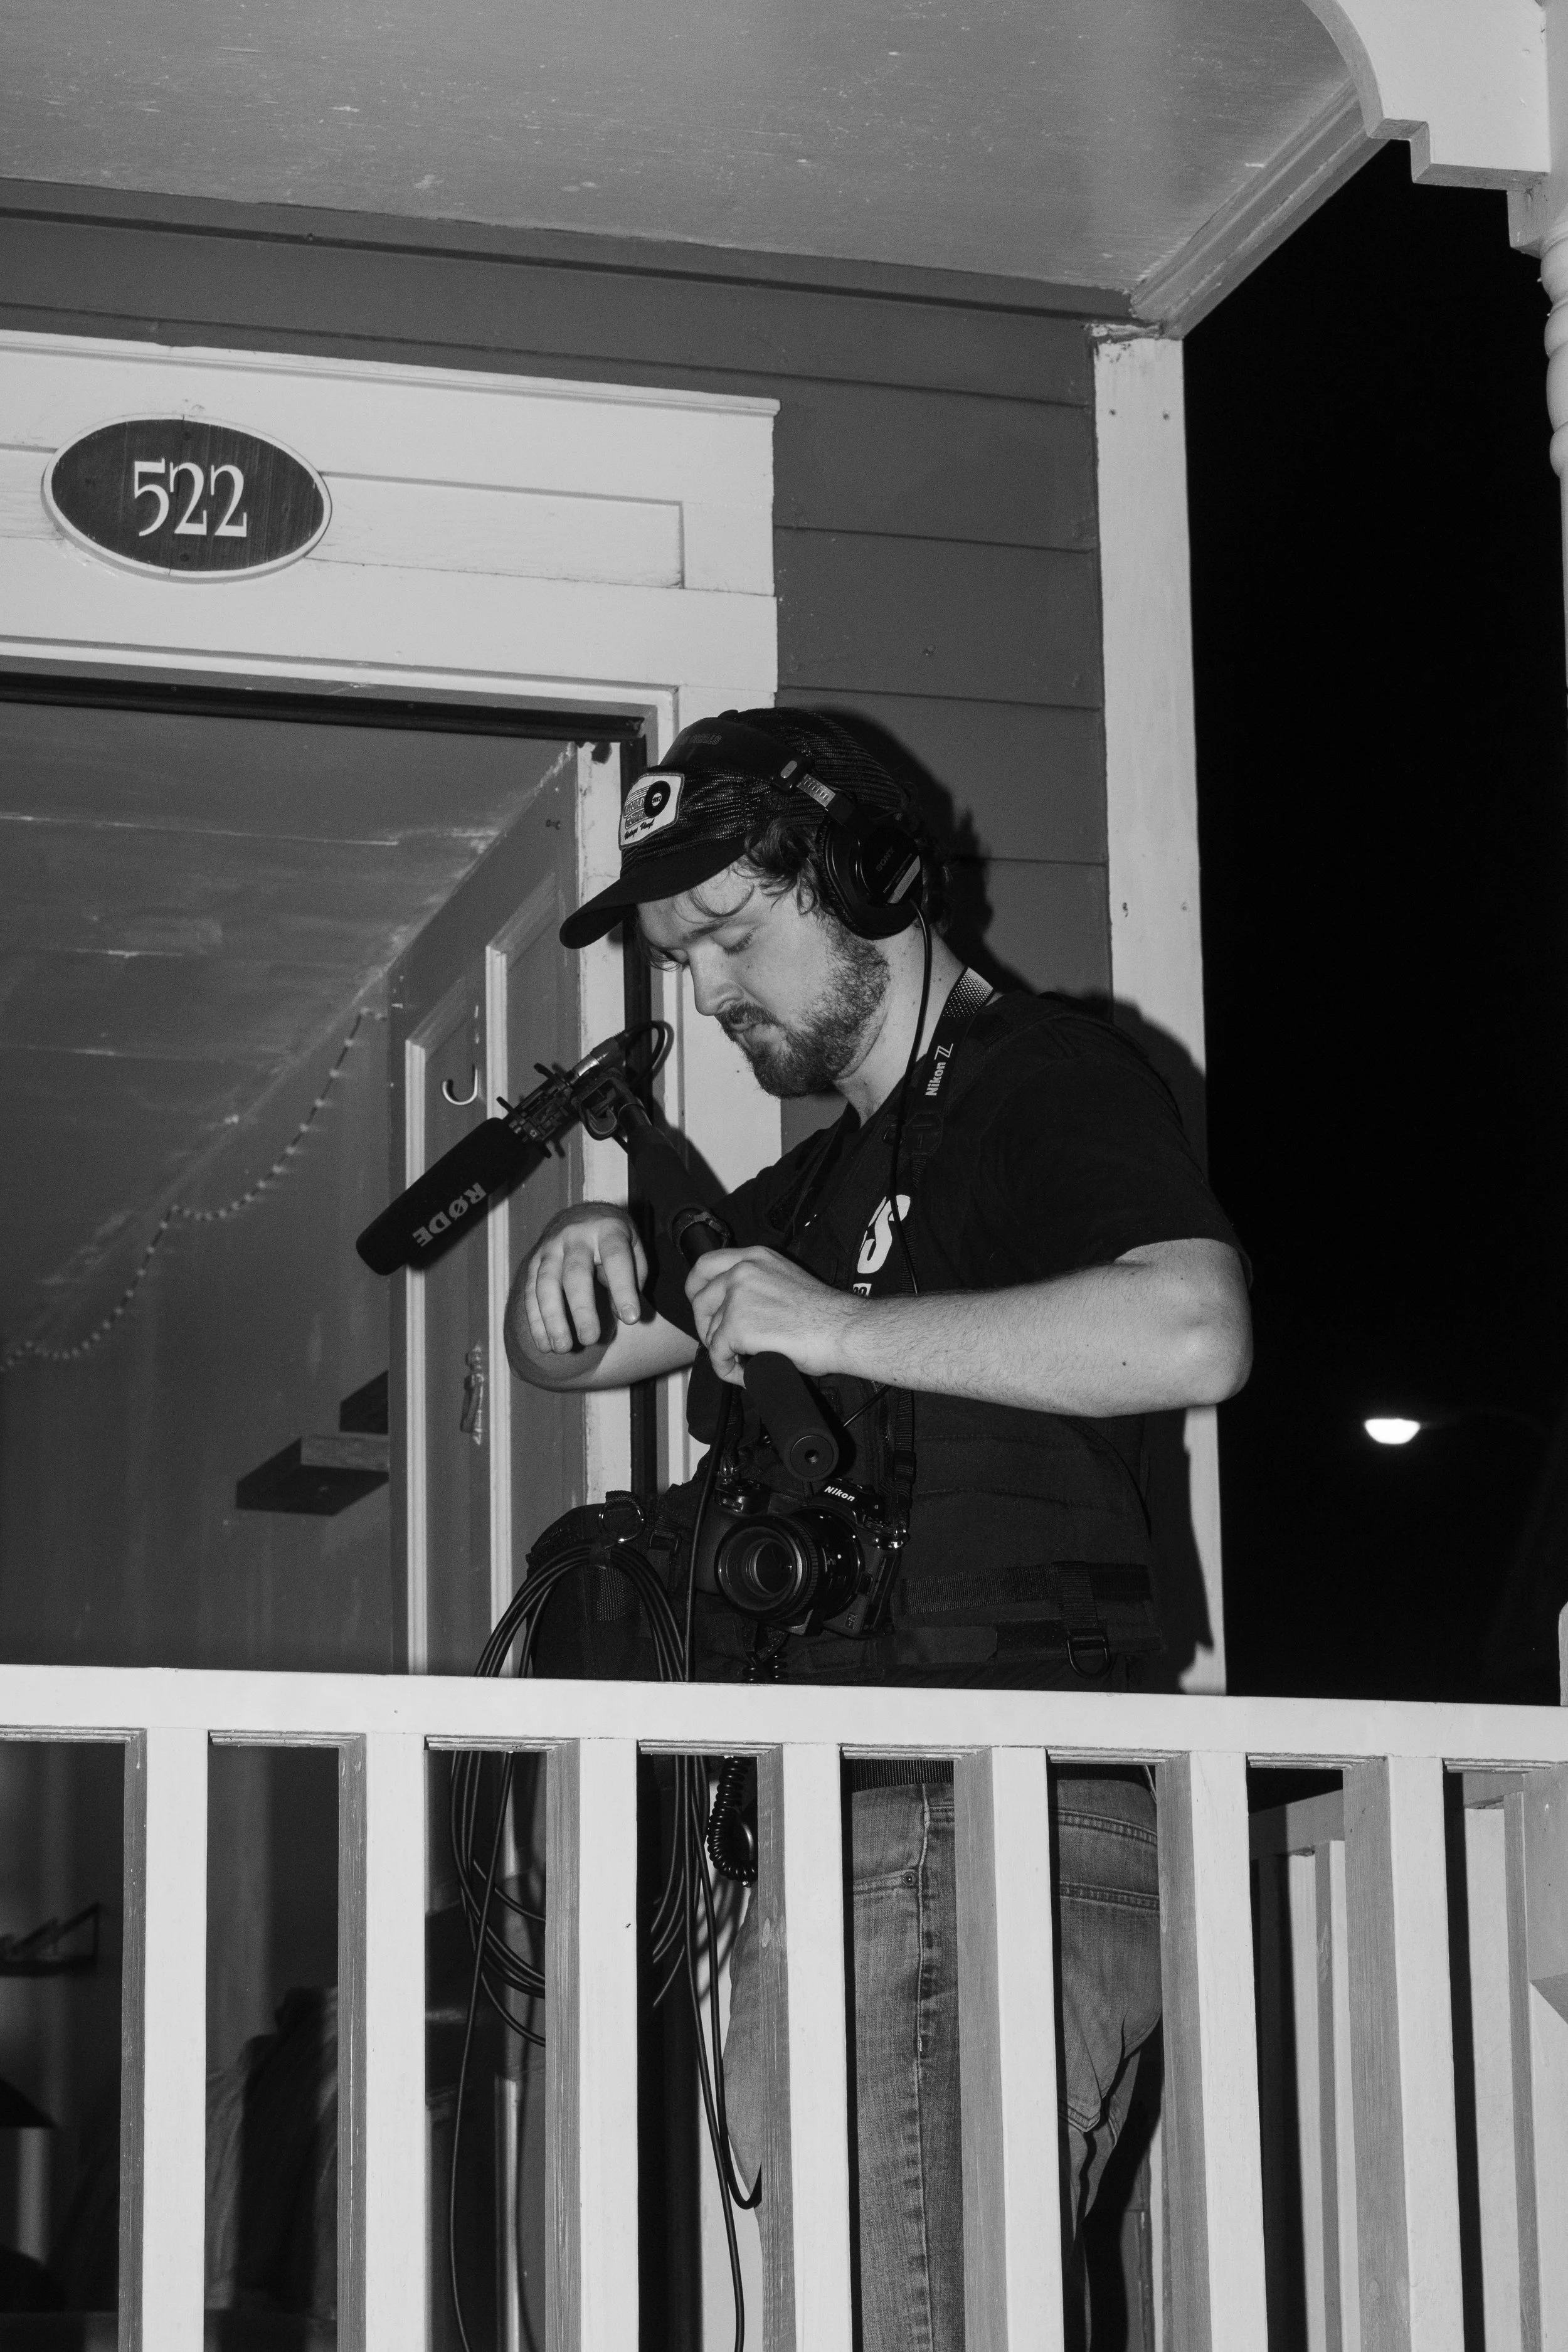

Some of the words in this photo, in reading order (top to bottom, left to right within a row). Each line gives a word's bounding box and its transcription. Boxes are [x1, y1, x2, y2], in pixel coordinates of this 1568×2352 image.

[134, 458, 247, 538] 522
[876, 846, 895, 872] SONY
[934, 1043, 954, 1060] Z
[924, 1062, 946, 1096] Nikon
[412, 1182, 487, 1248] RØDE
[824, 1485, 856, 1502] Nikon
